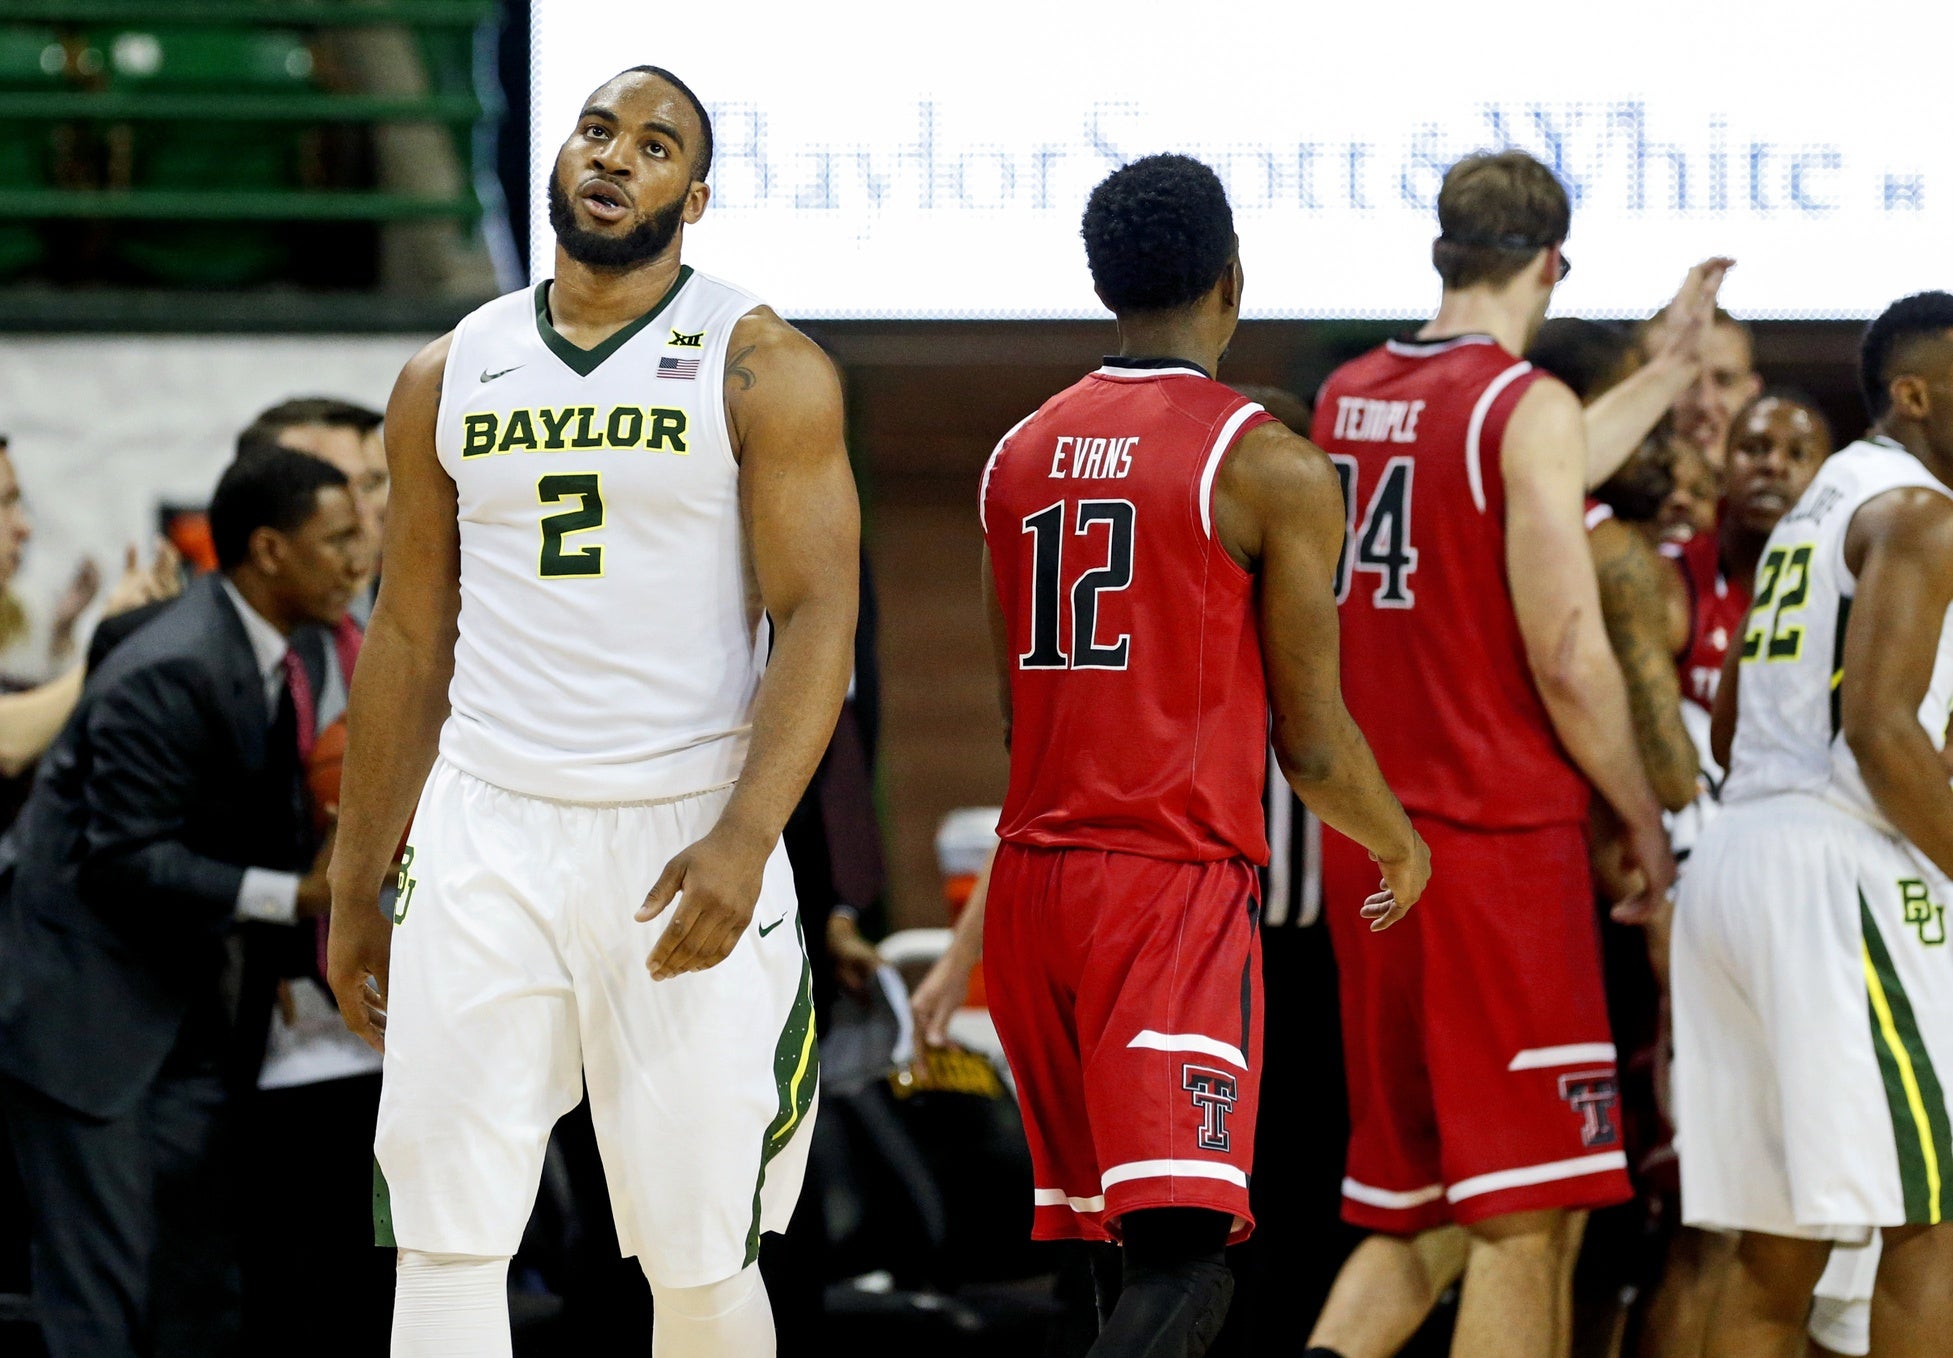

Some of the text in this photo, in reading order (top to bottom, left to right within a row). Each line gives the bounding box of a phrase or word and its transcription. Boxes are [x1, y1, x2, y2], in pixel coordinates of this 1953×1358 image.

[461, 405, 690, 460] BAYLOR
[1333, 396, 1427, 443] TEMPLE
[1048, 436, 1140, 479] EVANS
[537, 471, 605, 580] 2
[1018, 498, 1137, 671] 12
